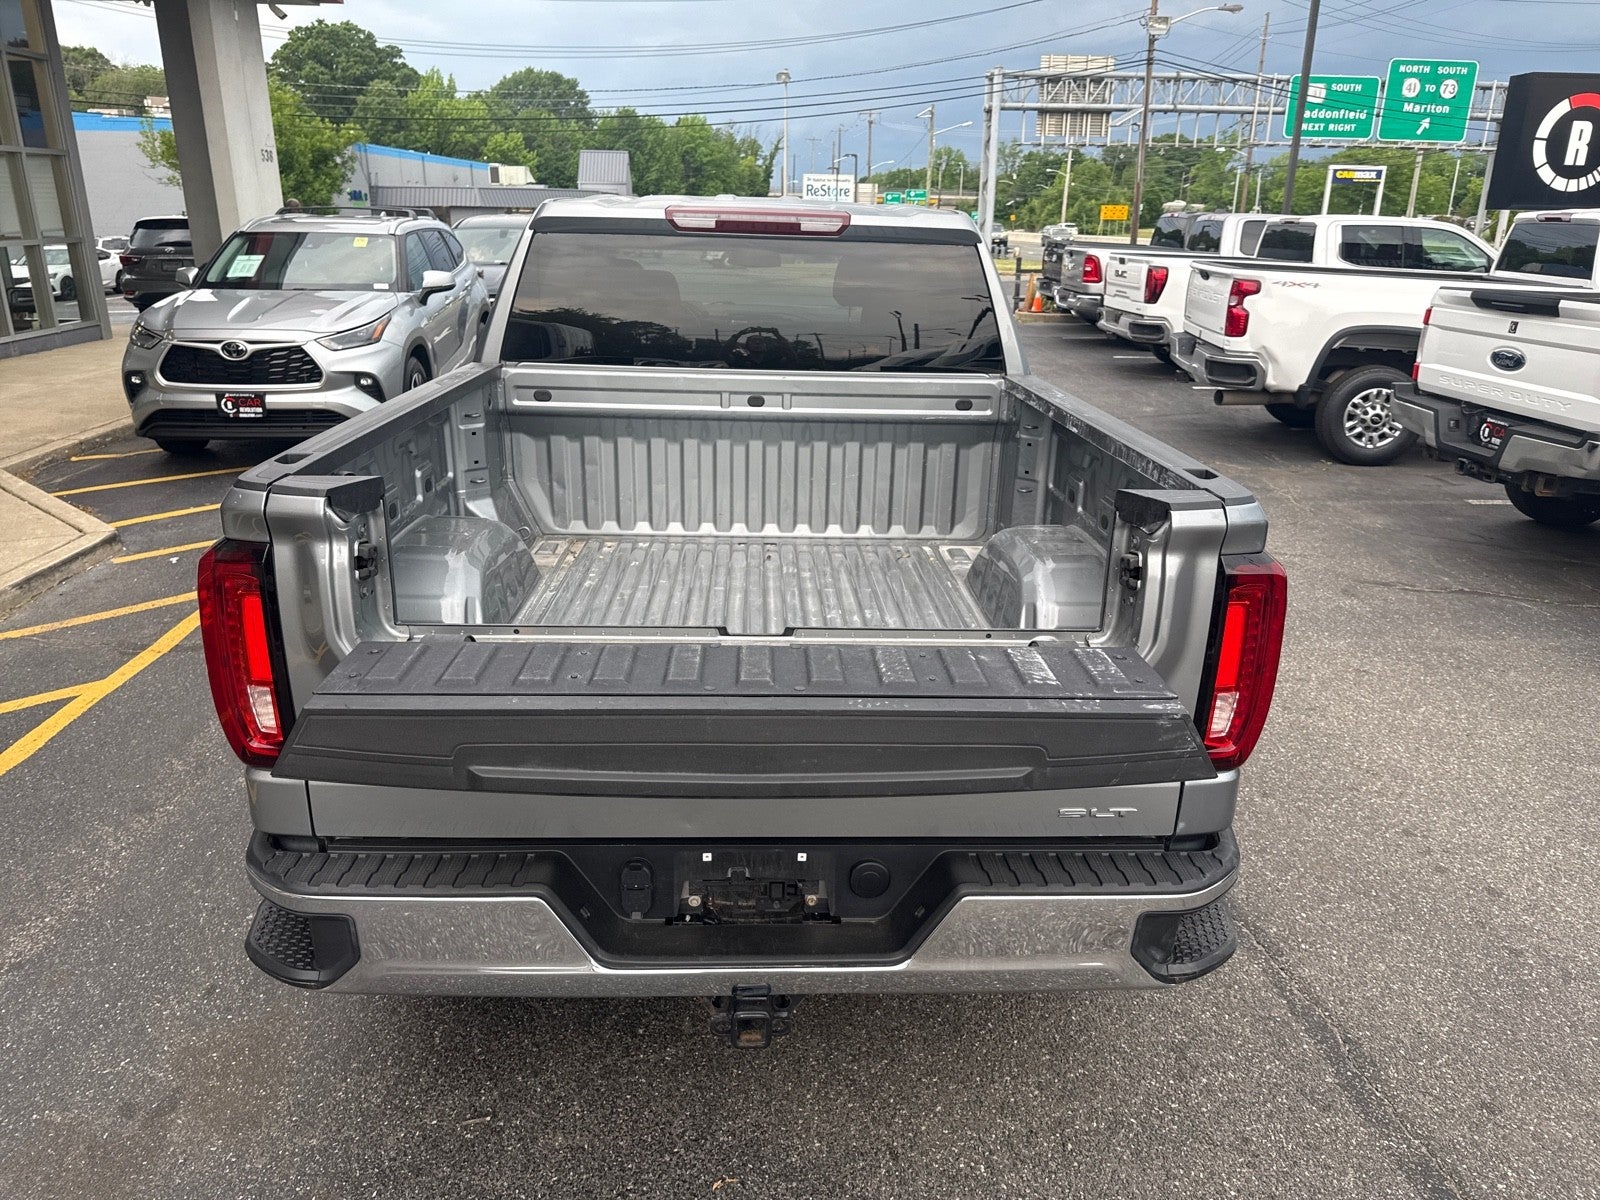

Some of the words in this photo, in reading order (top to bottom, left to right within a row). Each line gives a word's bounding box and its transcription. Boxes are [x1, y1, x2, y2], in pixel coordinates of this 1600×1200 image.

[1399, 65, 1430, 74] NORTH
[1437, 66, 1468, 75] SOUTH
[1331, 83, 1362, 92] SOUTH
[1406, 82, 1417, 94] 41
[1425, 84, 1436, 93] TO
[1442, 83, 1456, 95] 73
[1303, 108, 1367, 120] addonfield
[1403, 102, 1450, 114] Marlton
[1301, 122, 1325, 131] NEXT
[1328, 123, 1357, 132] RIGHT
[1563, 120, 1593, 166] R
[806, 184, 850, 198] ReStore
[1439, 374, 1503, 397] SUPER
[1509, 391, 1571, 411] DUTY
[239, 398, 261, 407] CAR
[1058, 807, 1138, 819] SLT
